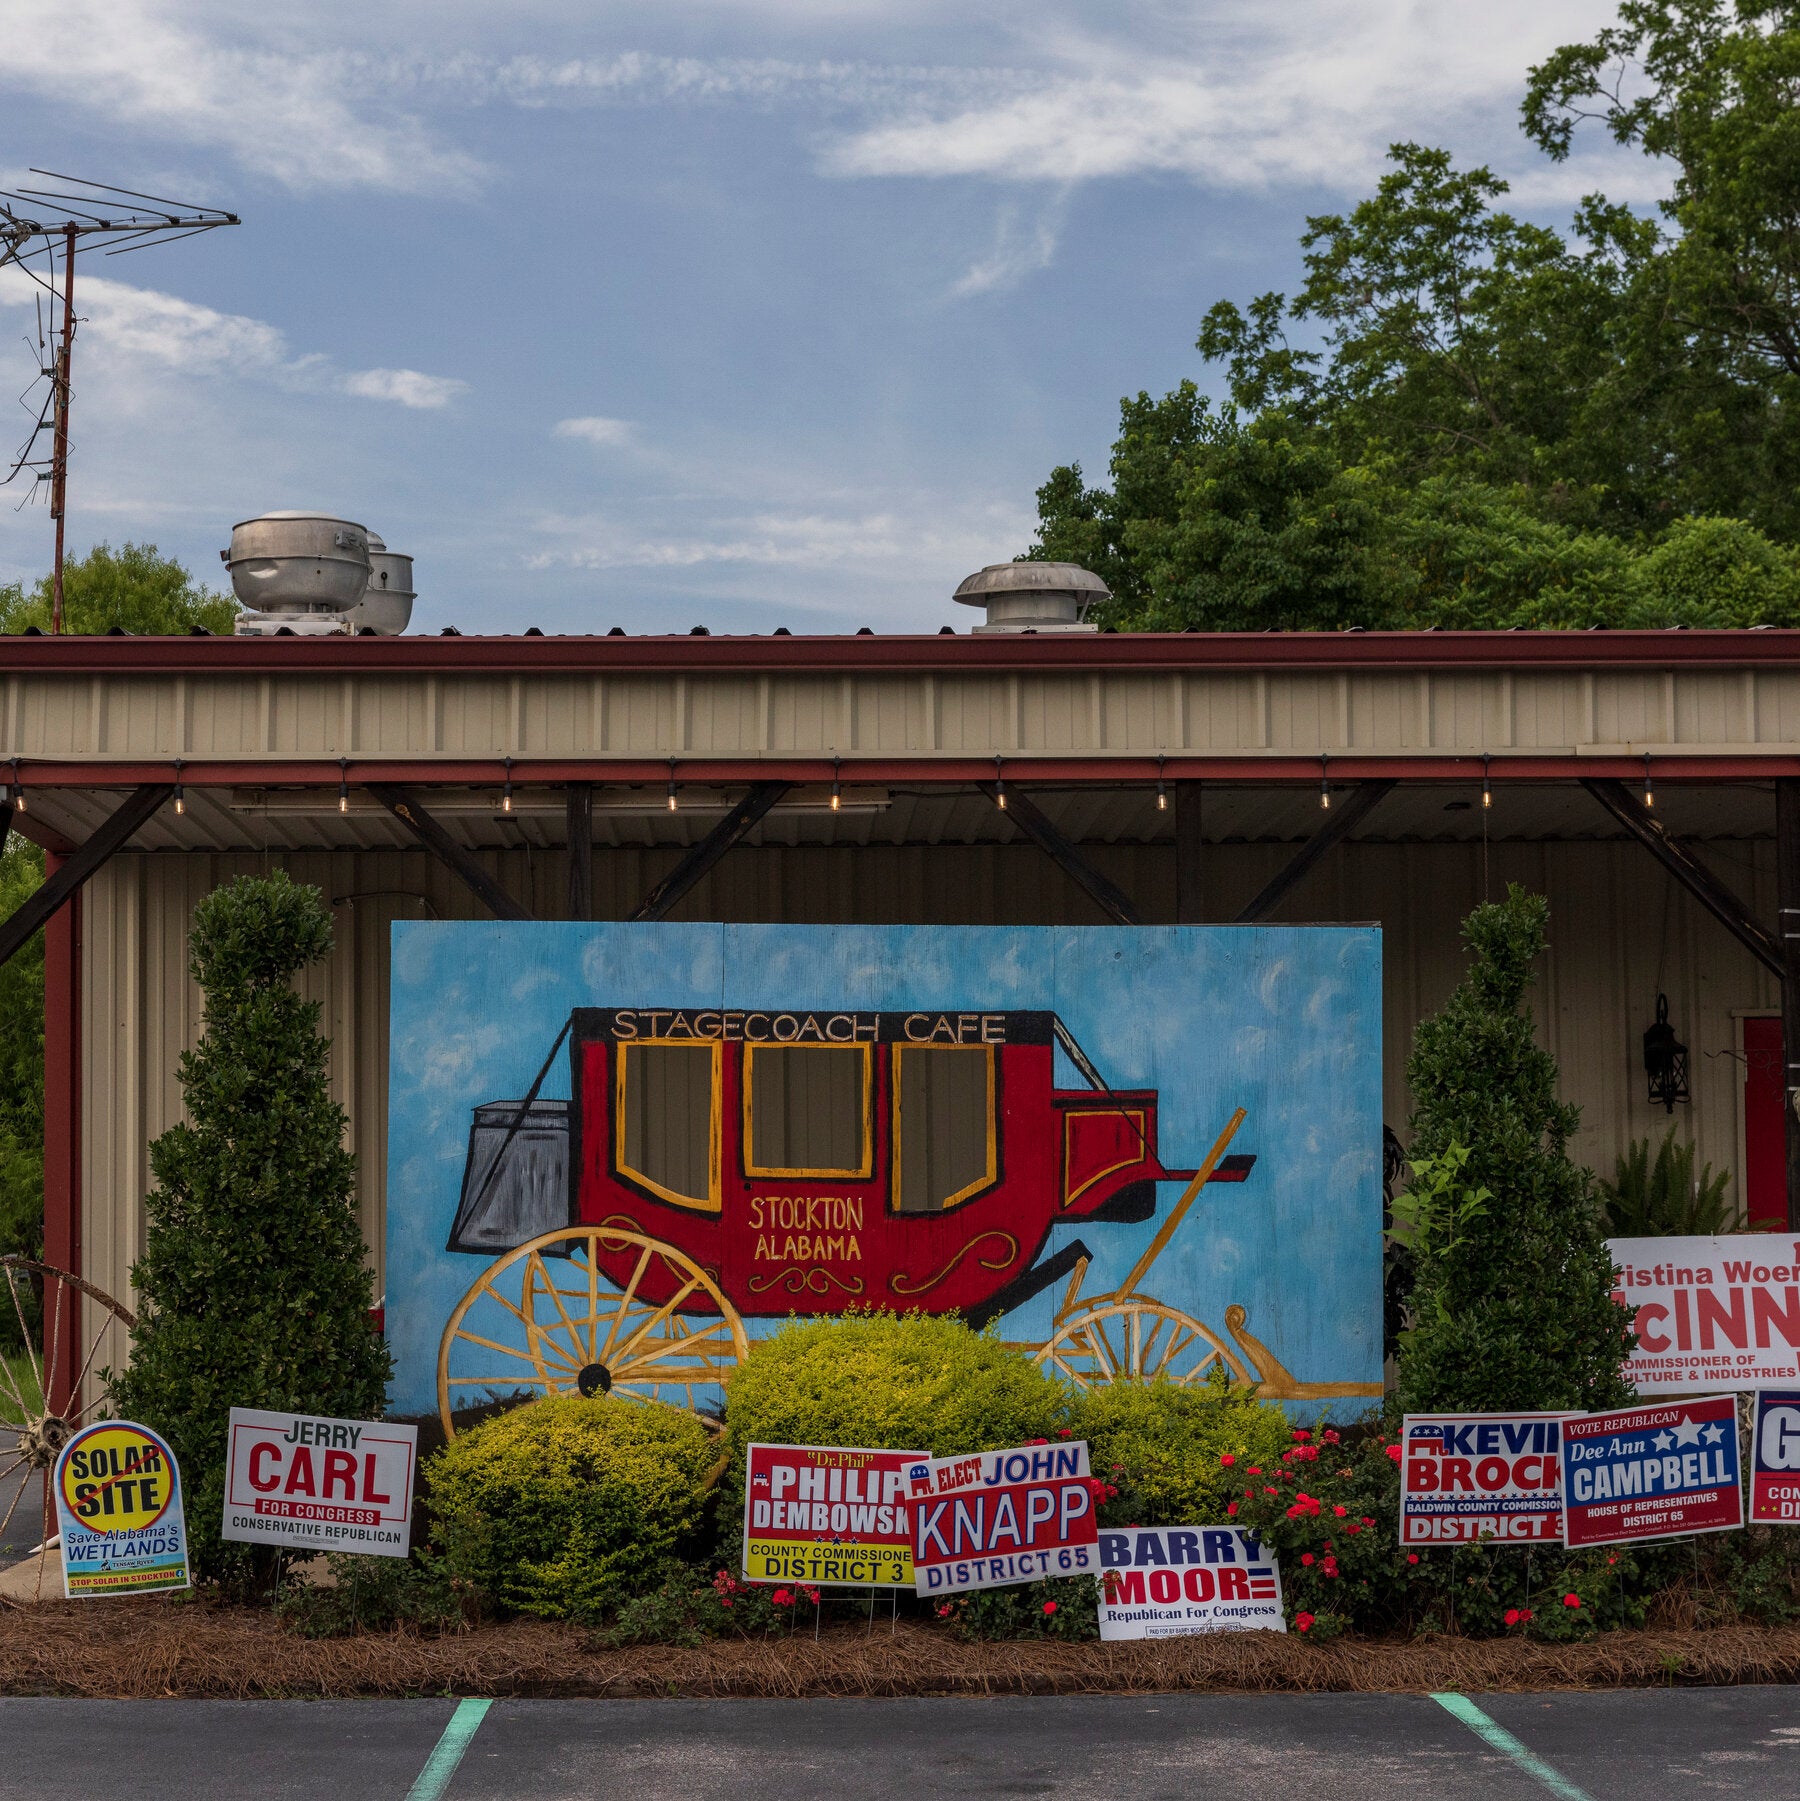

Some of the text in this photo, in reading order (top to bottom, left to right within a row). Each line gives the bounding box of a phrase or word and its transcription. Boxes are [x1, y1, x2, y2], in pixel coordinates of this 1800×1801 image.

[610, 1010, 1006, 1044] STAGECOACH CAFE
[748, 1196, 864, 1231] STOCKTON
[754, 1234, 862, 1261] ALABAMA
[1611, 1286, 1800, 1353] cINN
[1736, 1354, 1756, 1366] OF
[1617, 1367, 1796, 1383] ULTURE & INDUSTRIES
[283, 1420, 362, 1450] JERRY
[1569, 1410, 1680, 1436] VOTE REPUBLICAN
[71, 1444, 161, 1479] SOLAR
[1570, 1437, 1647, 1463] Dee Ann
[248, 1441, 391, 1505] CARL
[936, 1446, 1081, 1493] ELECT JOHN
[1573, 1448, 1732, 1502] CAMPBELL
[75, 1477, 161, 1517] SITE
[770, 1465, 905, 1505] PHILIP
[261, 1500, 375, 1524] FOR CONGRESS
[1406, 1502, 1455, 1513] BALDWIN
[1457, 1501, 1500, 1512] COUNTY
[1587, 1491, 1718, 1518] HOUSE OF REPRESENTATIVES
[232, 1516, 321, 1536] CONSERVATIVE
[325, 1526, 401, 1544] REPUBLICAN
[916, 1484, 1090, 1561] KNAPP
[1409, 1514, 1547, 1539] DISTRICT
[1623, 1509, 1684, 1528] DISTRICT 65
[67, 1524, 178, 1544] Save Alabama's
[68, 1537, 179, 1561] WETLANDS
[751, 1544, 911, 1562] COUNTY COMMISSIONE
[1097, 1529, 1264, 1568] BARRY
[71, 1579, 91, 1587] STOP
[93, 1577, 118, 1585] SOLAR
[131, 1571, 175, 1582] STOCKTON
[765, 1557, 904, 1582] DISTRICT 3
[925, 1545, 1090, 1590] DISTRICT 65
[1102, 1567, 1277, 1606] MOORE
[1107, 1604, 1276, 1623] Republican For Congress
